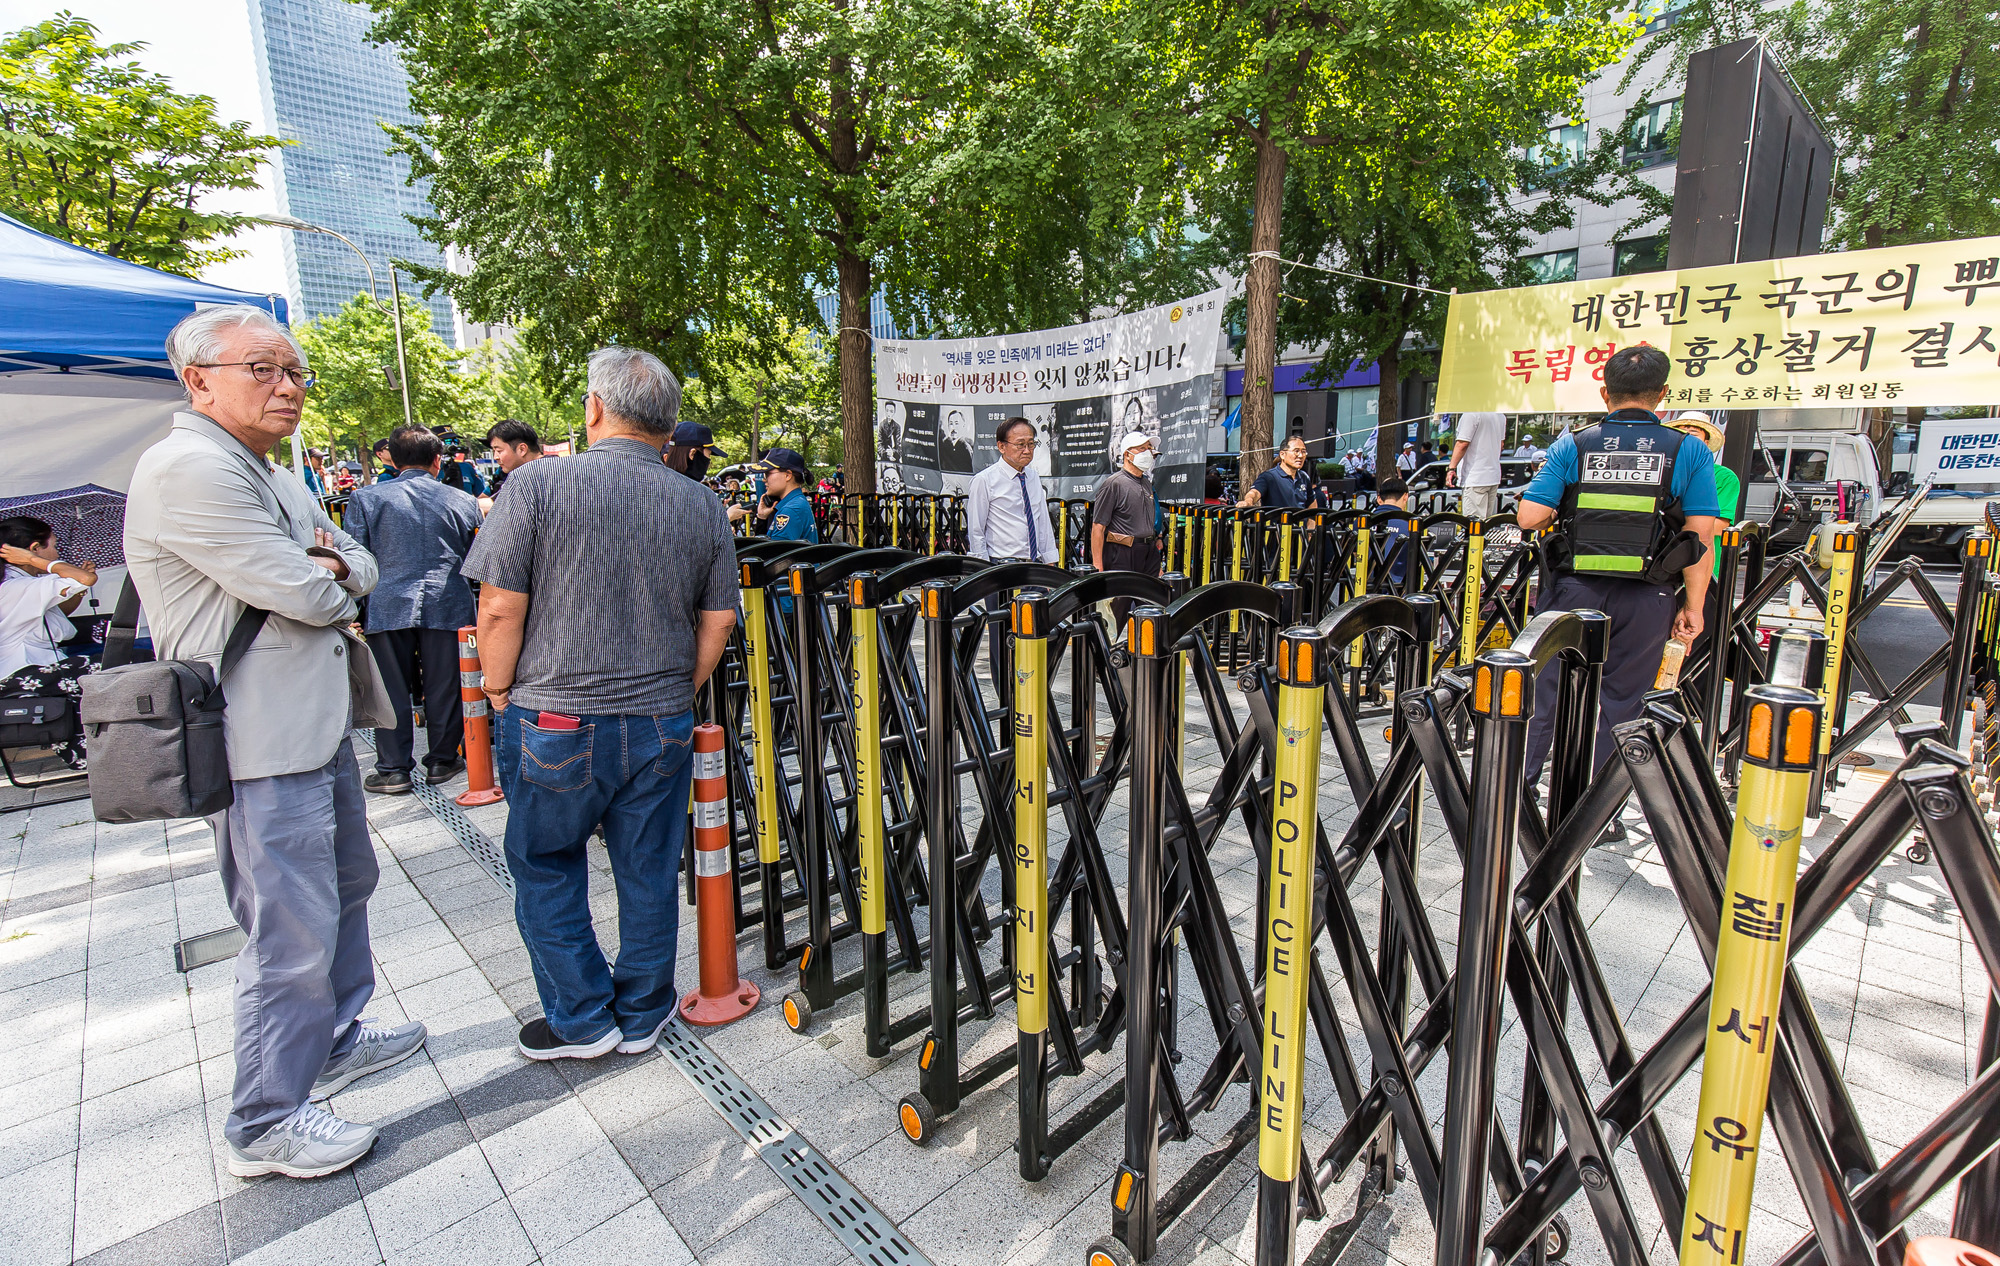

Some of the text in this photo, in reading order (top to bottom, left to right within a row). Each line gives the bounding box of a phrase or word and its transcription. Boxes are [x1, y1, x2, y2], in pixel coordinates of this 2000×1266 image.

[1571, 282, 1742, 333] 대한민국
[1759, 264, 1920, 319] 국군의
[895, 342, 1187, 394] 선열들의 희생정신을 잊지 않겠습니다!
[977, 349, 996, 365] 잊은
[1000, 345, 1041, 364] 민족에게
[1046, 341, 1079, 359] 미래는
[1505, 341, 1653, 385] 독립영
[1675, 326, 1877, 378] 흉상철거
[1720, 385, 1803, 403] 수호하는
[1811, 382, 1904, 401] 회원일동
[1603, 436, 1656, 451] 경찰
[1940, 433, 2000, 450] 대한민
[1592, 455, 1654, 470] 경찰
[1592, 470, 1652, 481] POLICE
[1465, 564, 1476, 625] POLICE
[1825, 589, 1844, 668] POLICE
[1267, 780, 1299, 1134] POLICE LINE
